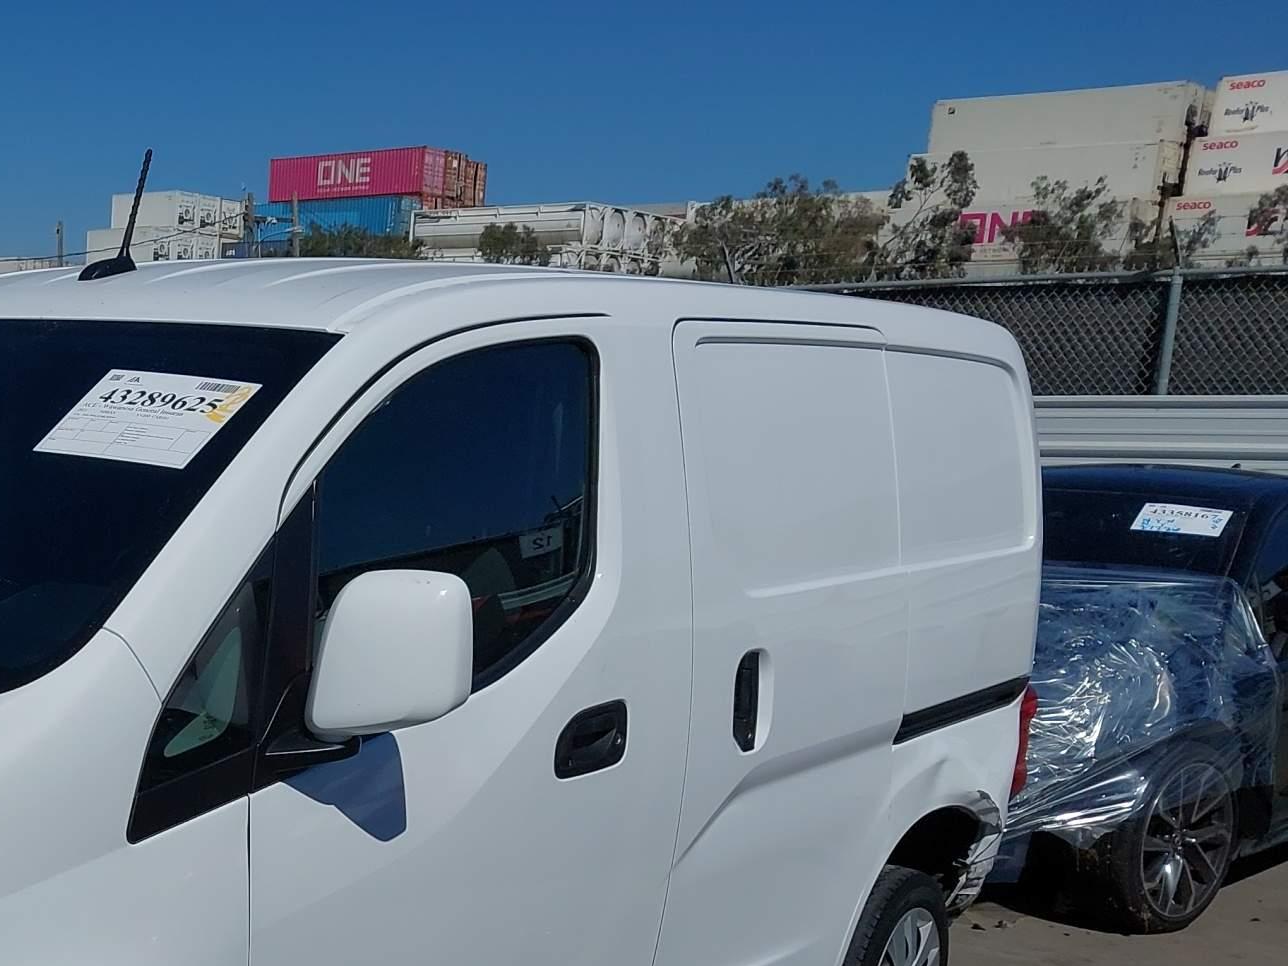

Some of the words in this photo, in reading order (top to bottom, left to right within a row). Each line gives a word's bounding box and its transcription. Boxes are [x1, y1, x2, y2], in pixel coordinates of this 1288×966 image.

[1229, 79, 1266, 91] seaco
[1202, 140, 1239, 151] seaco
[317, 157, 371, 186] ONE
[1175, 201, 1212, 211] seaco
[98, 388, 224, 414] 43289625
